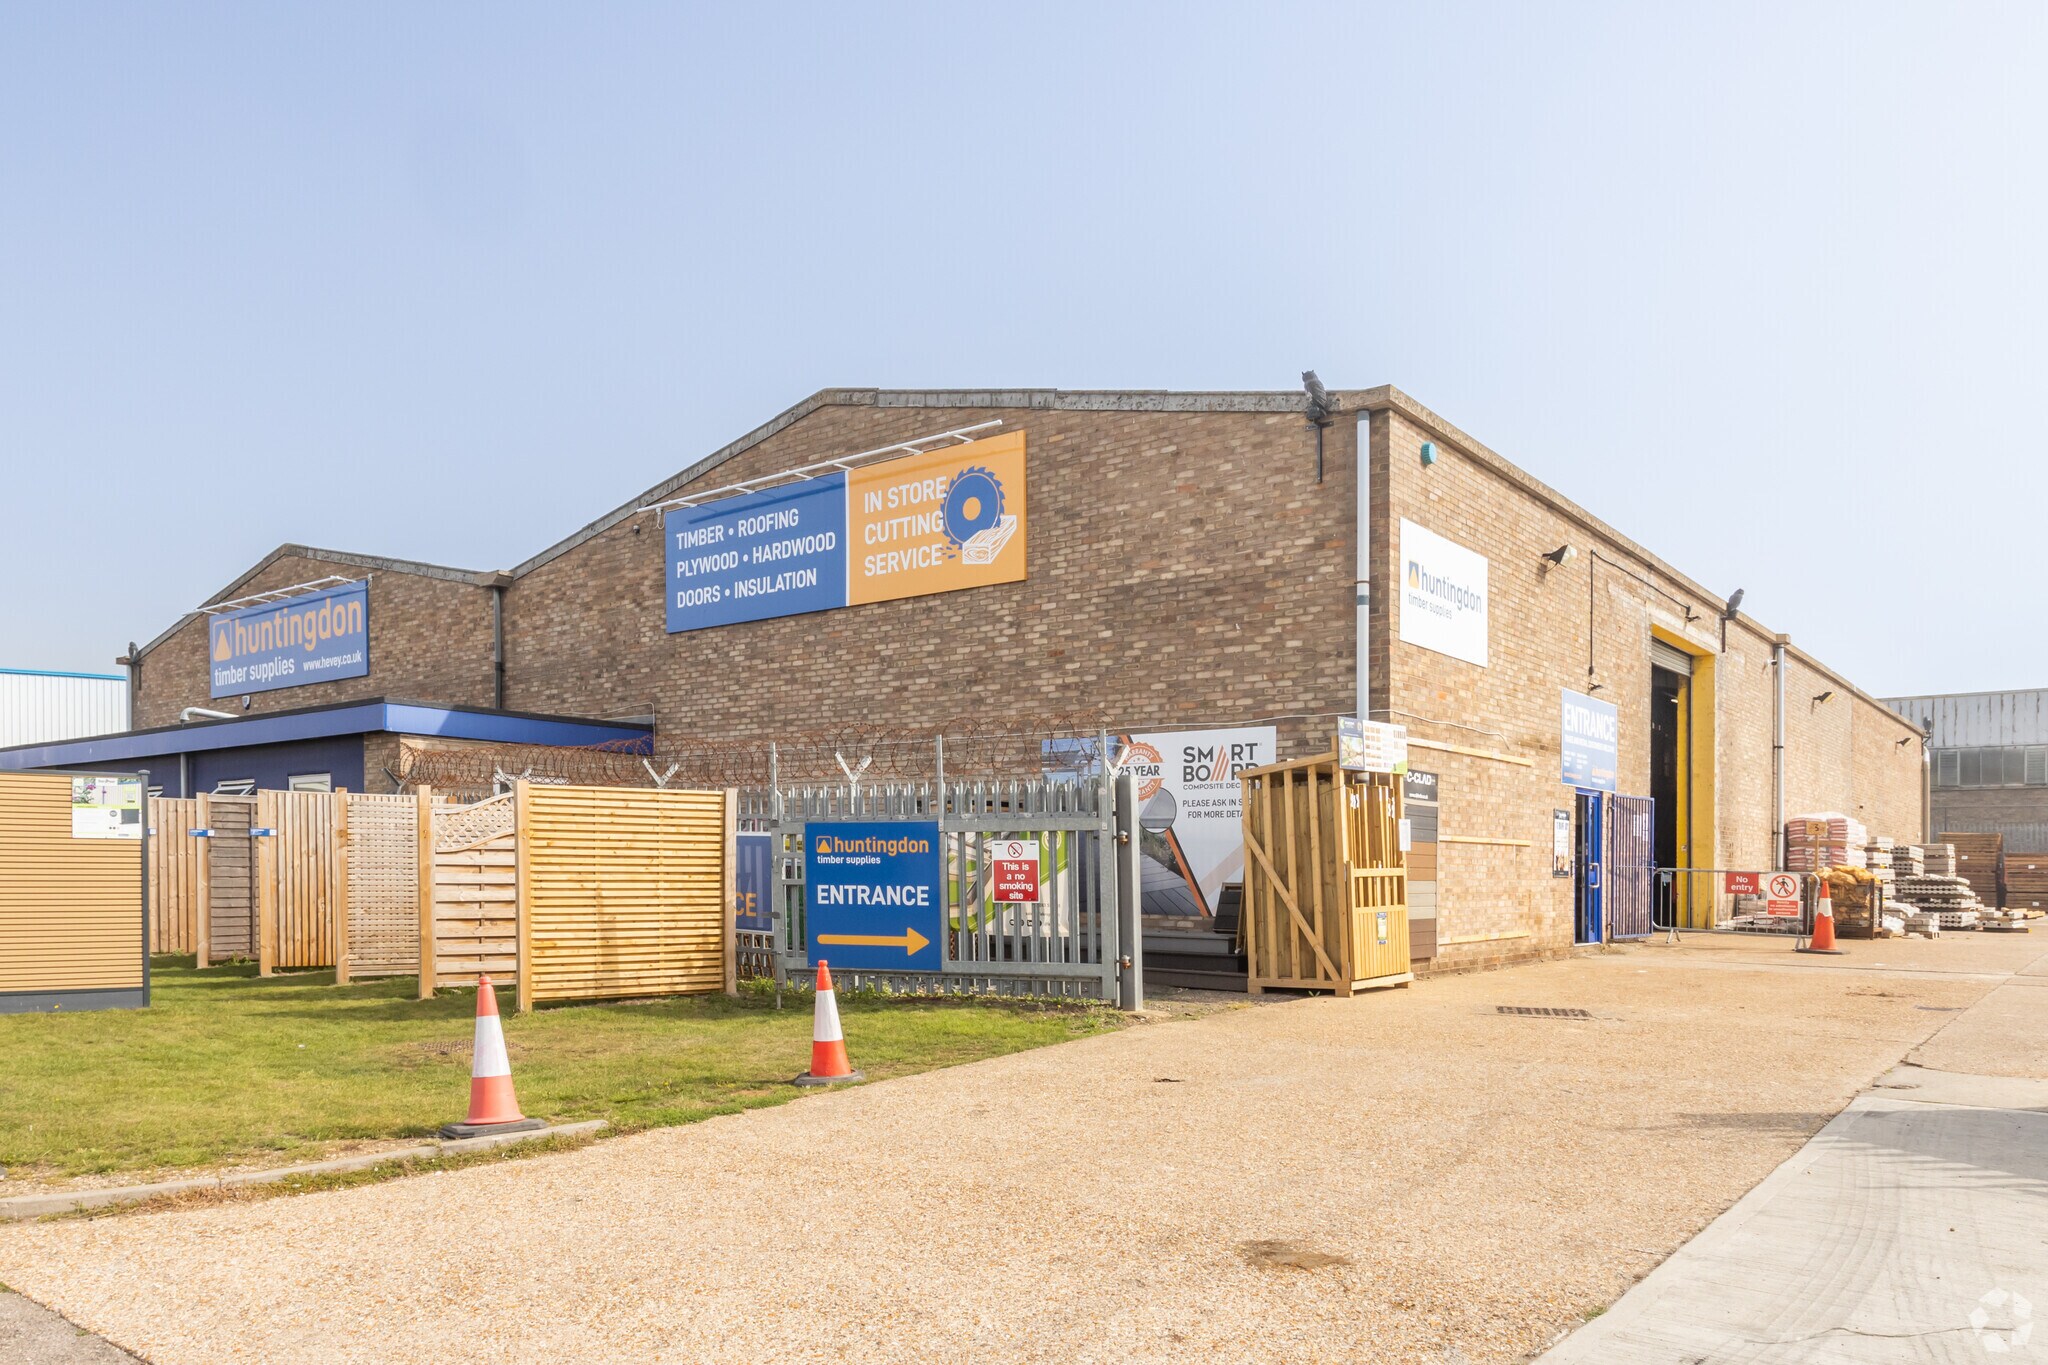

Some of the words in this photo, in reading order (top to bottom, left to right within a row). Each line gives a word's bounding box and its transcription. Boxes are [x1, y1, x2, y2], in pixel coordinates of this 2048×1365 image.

[864, 490, 883, 515] IN
[886, 475, 948, 509] STORE
[676, 527, 725, 550] TIMBER
[738, 508, 799, 538] ROOFING
[864, 510, 944, 545] CUTTING
[676, 555, 739, 579] PLYWOOD
[752, 531, 836, 565] HARDWOOD
[864, 543, 943, 577] SERVICE
[676, 587, 721, 609] DOORS
[734, 567, 817, 599] INSULATION
[1421, 565, 1482, 614] huntingdon
[1408, 593, 1428, 610] timber
[1429, 601, 1453, 620] supplies
[235, 596, 362, 657] huntingdon
[214, 666, 248, 687] timber
[249, 656, 295, 683] supplies
[302, 650, 362, 672] www.hevey.co.uk
[1564, 703, 1615, 743] ENTRANCE
[1133, 765, 1160, 776] YEAR
[1182, 799, 1210, 807] PLEASE
[1211, 799, 1227, 807] ASK
[1228, 798, 1237, 806] IN
[1187, 811, 1202, 819] FOR
[1203, 810, 1225, 818] MORE
[834, 836, 929, 857] huntingdon
[817, 855, 844, 865] timber
[845, 855, 881, 866] supplies
[1002, 862, 1020, 871] This
[1021, 862, 1030, 871] is
[999, 881, 1034, 892] smoking
[1735, 875, 1749, 883] No
[817, 884, 930, 906] ENTRANCE
[1009, 891, 1024, 900] site
